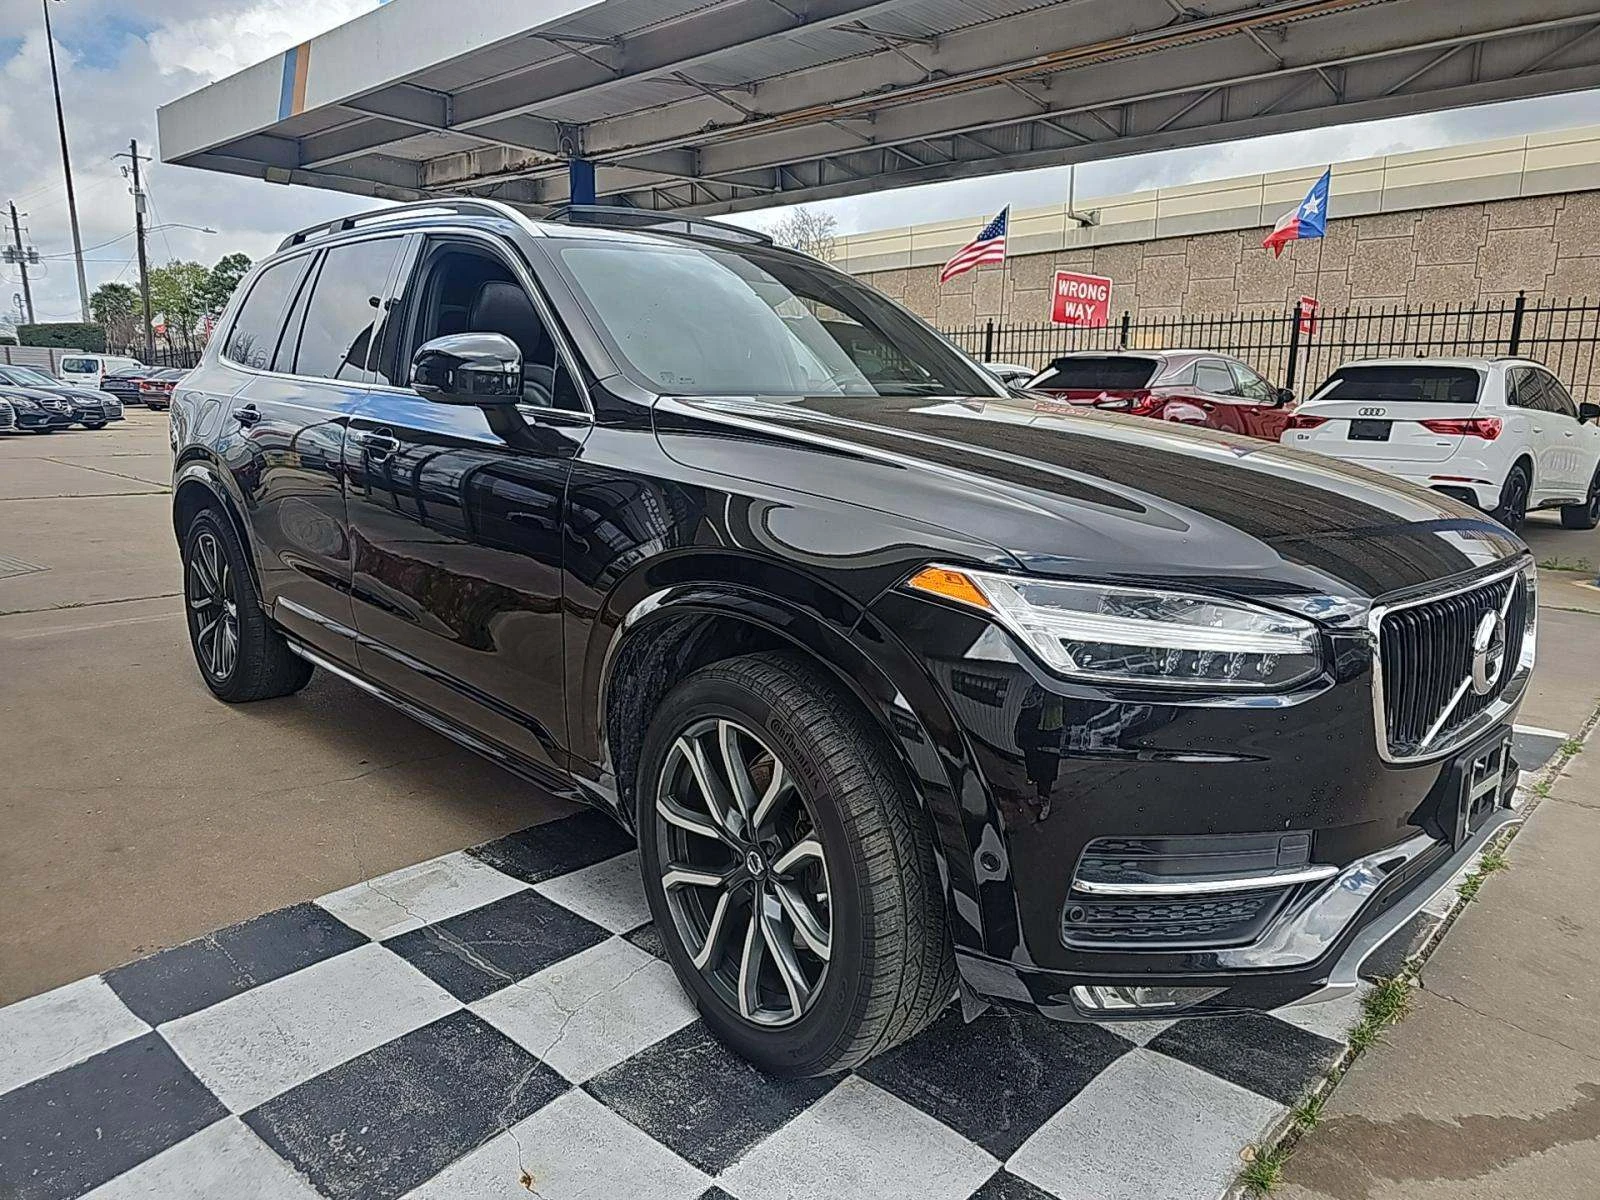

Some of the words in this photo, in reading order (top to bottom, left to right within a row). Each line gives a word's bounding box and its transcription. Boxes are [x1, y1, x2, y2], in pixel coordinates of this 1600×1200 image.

[1058, 279, 1107, 301] WRONG
[1065, 301, 1096, 320] WAY
[771, 719, 816, 780] Continental
